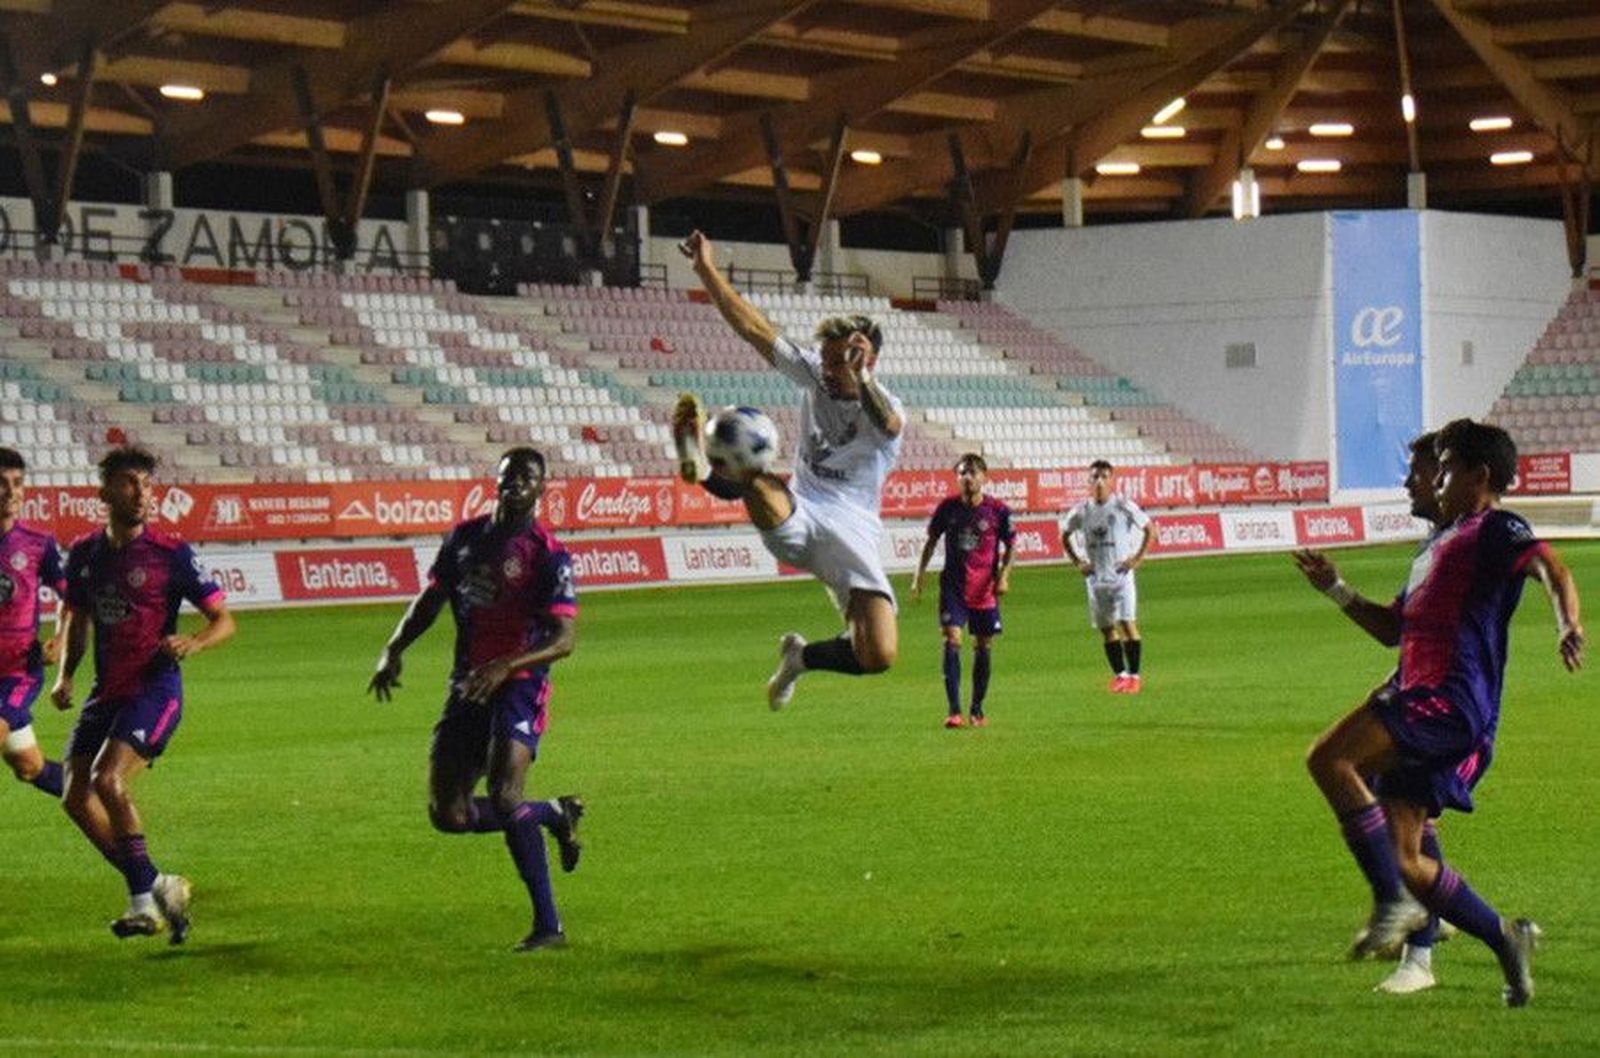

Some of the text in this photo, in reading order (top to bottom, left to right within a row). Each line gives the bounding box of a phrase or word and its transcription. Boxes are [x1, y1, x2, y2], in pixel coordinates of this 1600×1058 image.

[374, 491, 453, 524] boizas
[572, 549, 641, 578] antania
[682, 541, 752, 570] lantania
[298, 557, 388, 590] lantania
